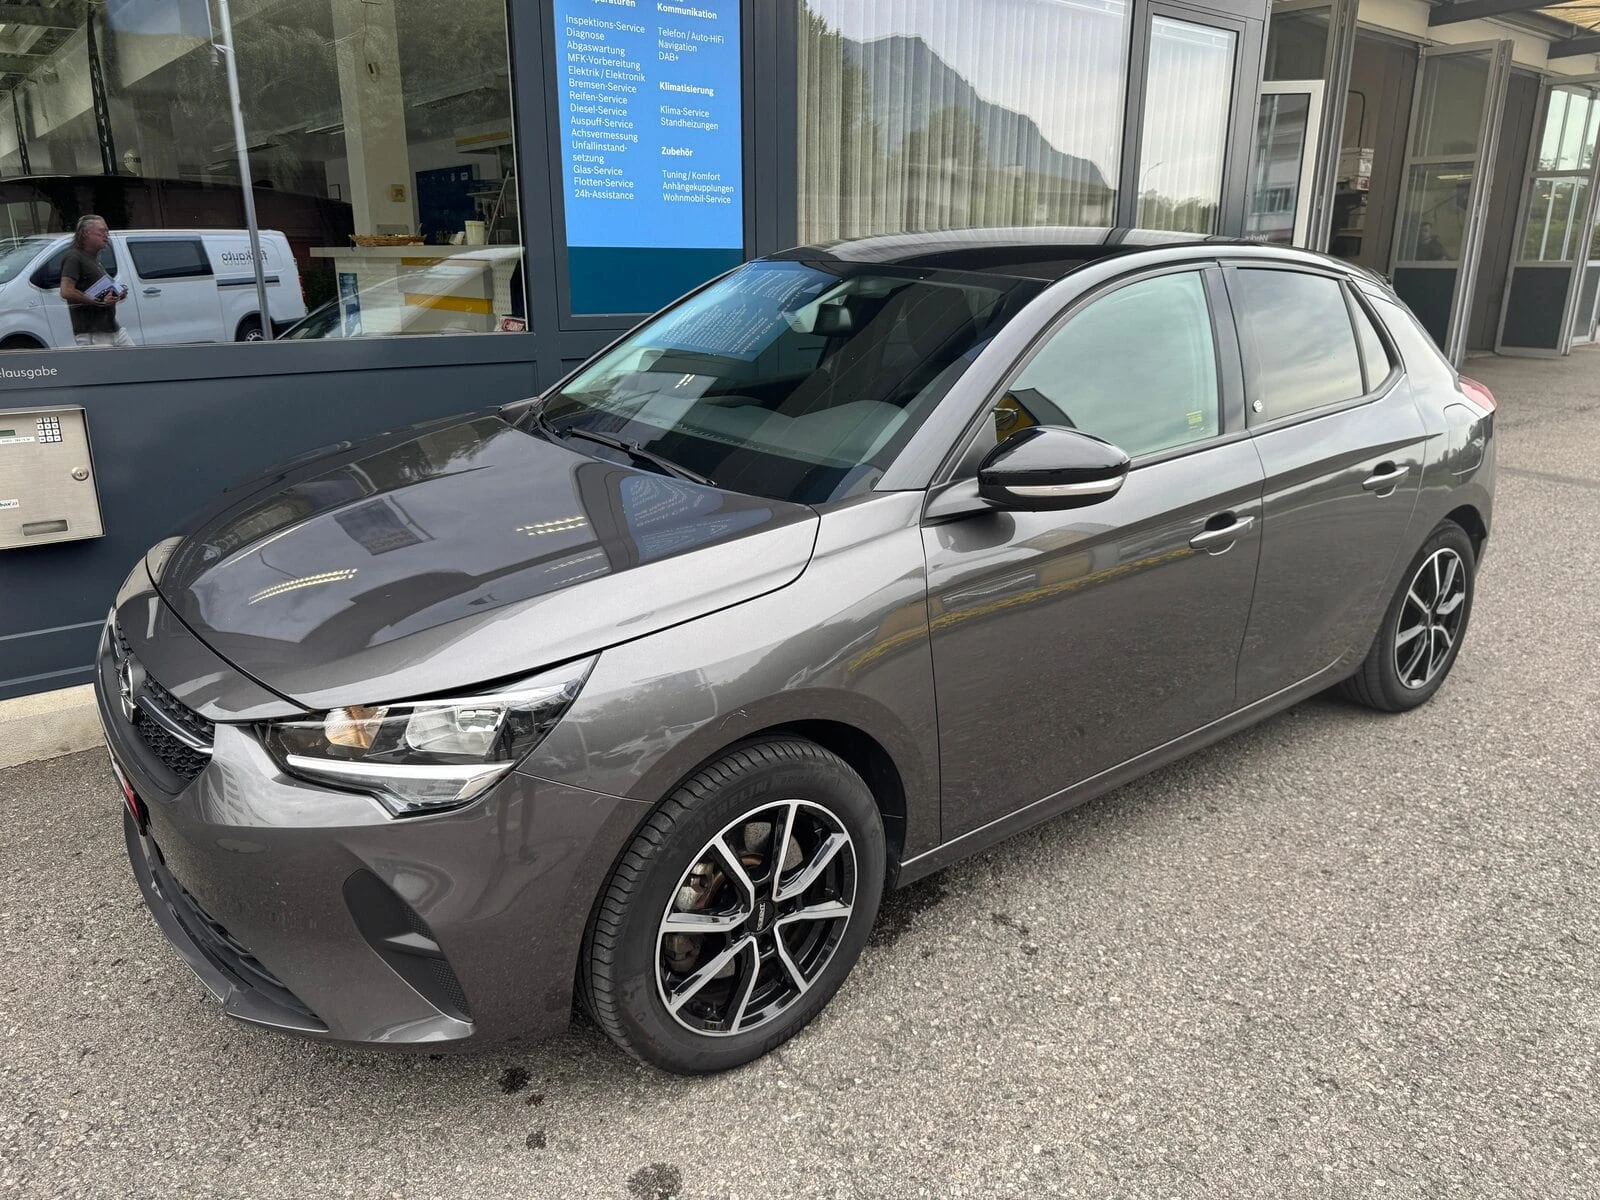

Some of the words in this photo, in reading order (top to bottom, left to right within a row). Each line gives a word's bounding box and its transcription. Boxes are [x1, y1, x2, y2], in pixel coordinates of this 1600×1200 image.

[657, 3, 717, 19] Kommunikation
[566, 15, 645, 33] Inspektions-Service
[567, 27, 604, 40] Diagnose
[567, 41, 625, 57] Abgaswartung
[659, 40, 697, 52] Navigation
[568, 53, 640, 71] MFK-Vorbereitung
[659, 52, 678, 61] DAB+
[569, 78, 636, 93] Bremsen-Service
[660, 81, 714, 97] Klimatisierung
[570, 91, 627, 104] Reifen-Service
[570, 103, 627, 117] Diesel-Service
[660, 105, 709, 118] Klima-Service
[571, 116, 633, 128] Auspuff-Service
[661, 117, 718, 131] Standheizungen
[572, 129, 638, 143] Achsvermessung
[572, 141, 627, 152] Unfallinstand-
[662, 147, 693, 156] Zubehör
[573, 153, 604, 165] setzung
[574, 165, 623, 175] Glas-Service
[574, 177, 633, 188] Flotten-Service
[663, 182, 734, 194] Anhängekupplungen
[575, 189, 634, 199] 24h-Assistance
[663, 193, 731, 203] Wohnmobil-Service
